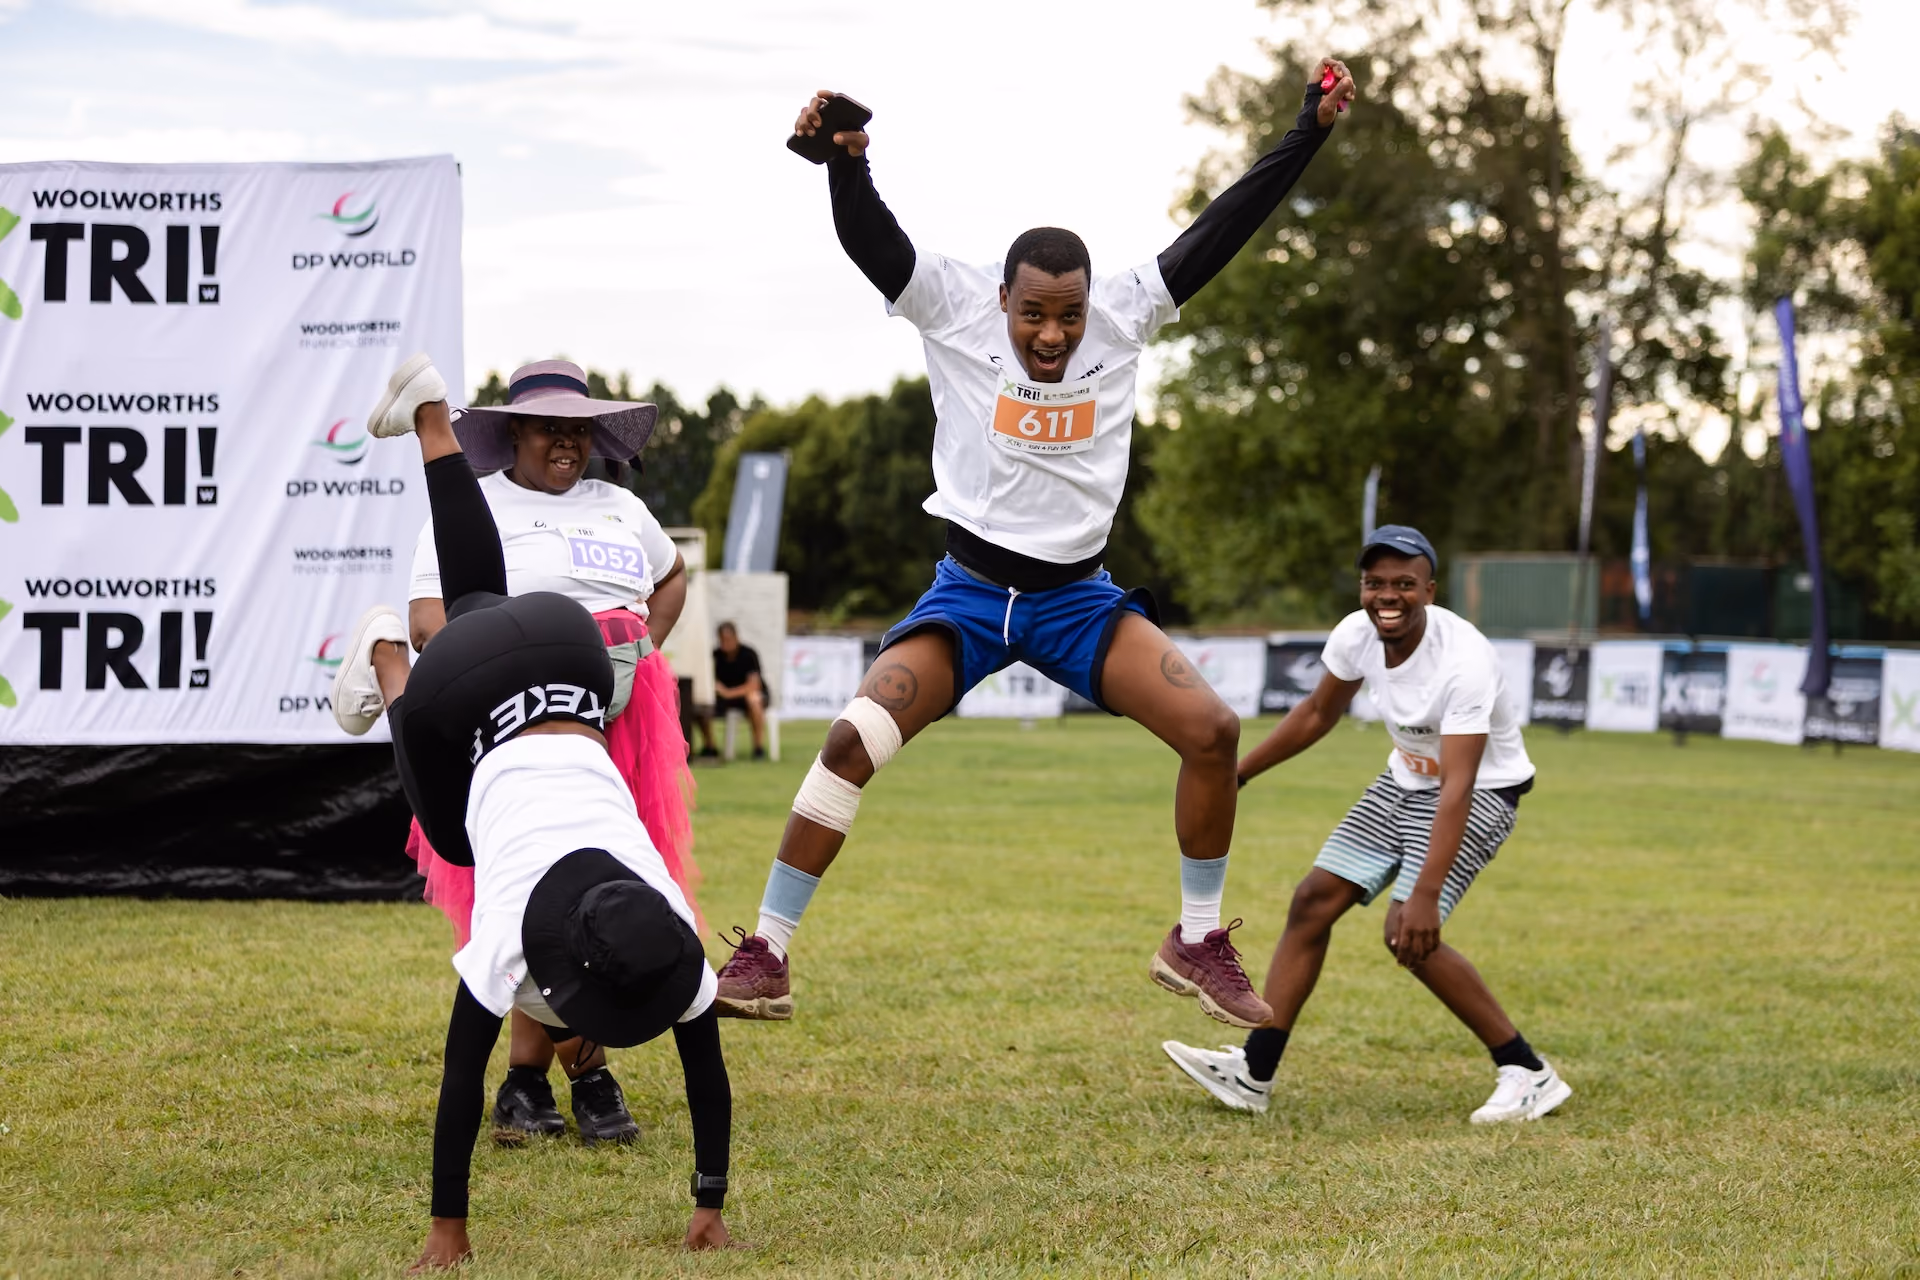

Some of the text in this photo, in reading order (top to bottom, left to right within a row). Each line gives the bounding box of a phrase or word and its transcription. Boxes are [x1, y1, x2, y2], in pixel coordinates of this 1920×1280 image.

[33, 189, 222, 211] WOOLWORTHS
[30, 222, 220, 304] TRI!
[293, 250, 416, 270] DP WORLD
[301, 320, 400, 335] WOOLWORTHS
[27, 393, 219, 413] WOOLWORTHS
[1017, 386, 1040, 401] TRI!
[1018, 409, 1074, 438] 611
[25, 426, 217, 505] TRI!
[286, 479, 404, 497] DP WORLD
[576, 542, 639, 573] 1052
[25, 579, 216, 598] WOOLWORTHS
[23, 612, 213, 689] TRI!
[280, 697, 309, 712] DP
